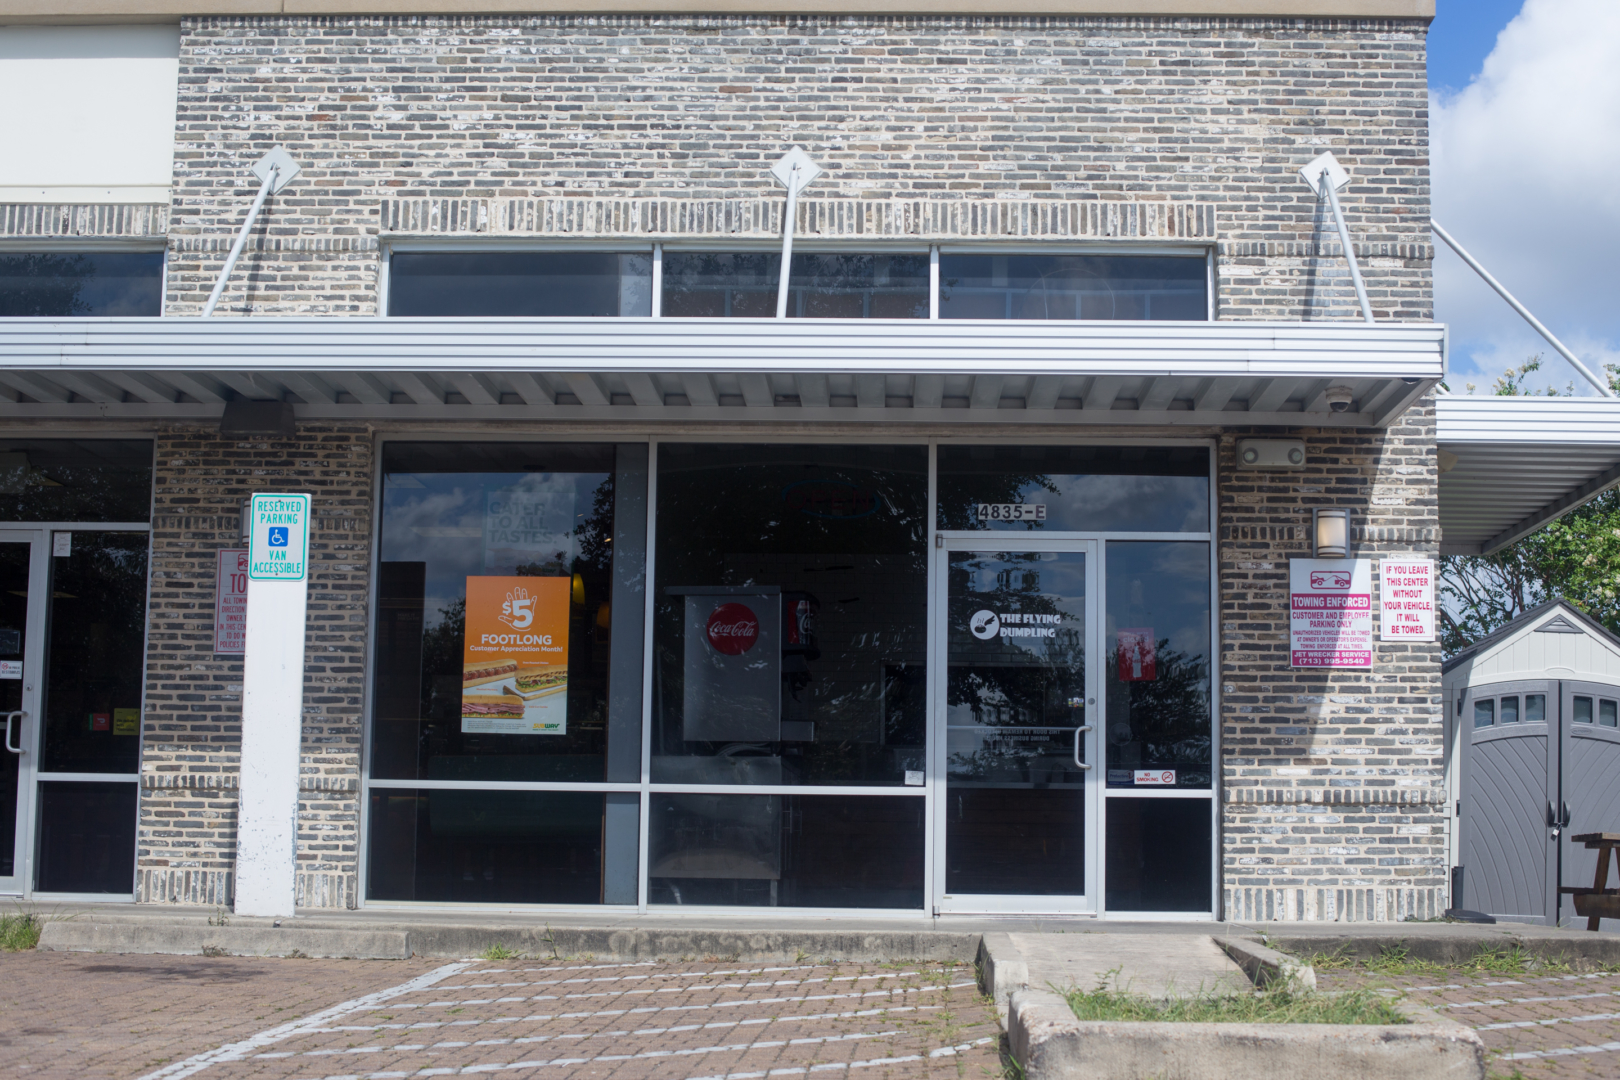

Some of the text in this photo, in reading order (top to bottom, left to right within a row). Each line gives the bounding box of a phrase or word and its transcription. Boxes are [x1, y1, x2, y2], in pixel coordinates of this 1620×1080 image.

[787, 490, 869, 510] OPEN
[258, 501, 301, 512] RESERVED
[490, 502, 546, 516] CATER
[980, 505, 1045, 519] 4835-E
[260, 513, 298, 524] PARKING
[489, 516, 548, 530] TO ALL
[488, 530, 556, 544] TASTES.
[269, 550, 286, 560] VAN
[253, 562, 301, 574] ACCESSIBLE
[1386, 566, 1428, 574] IF YOU LEAVE
[230, 573, 247, 593] TO
[1387, 578, 1428, 586] THIS CENTER
[1393, 590, 1422, 598] WITHOUT
[1293, 597, 1368, 607] TOWING ENFORCED
[1384, 602, 1432, 611] YOUR VEHICLE,
[502, 599, 533, 628] $5
[1000, 614, 1061, 624] THE FLYING
[1397, 614, 1419, 622] IT WILL
[710, 621, 757, 636] Coca-Cola
[1000, 627, 1056, 638] DUMPLING
[1392, 625, 1425, 634] BE TOWED.
[482, 634, 552, 645] FOOTLONG
